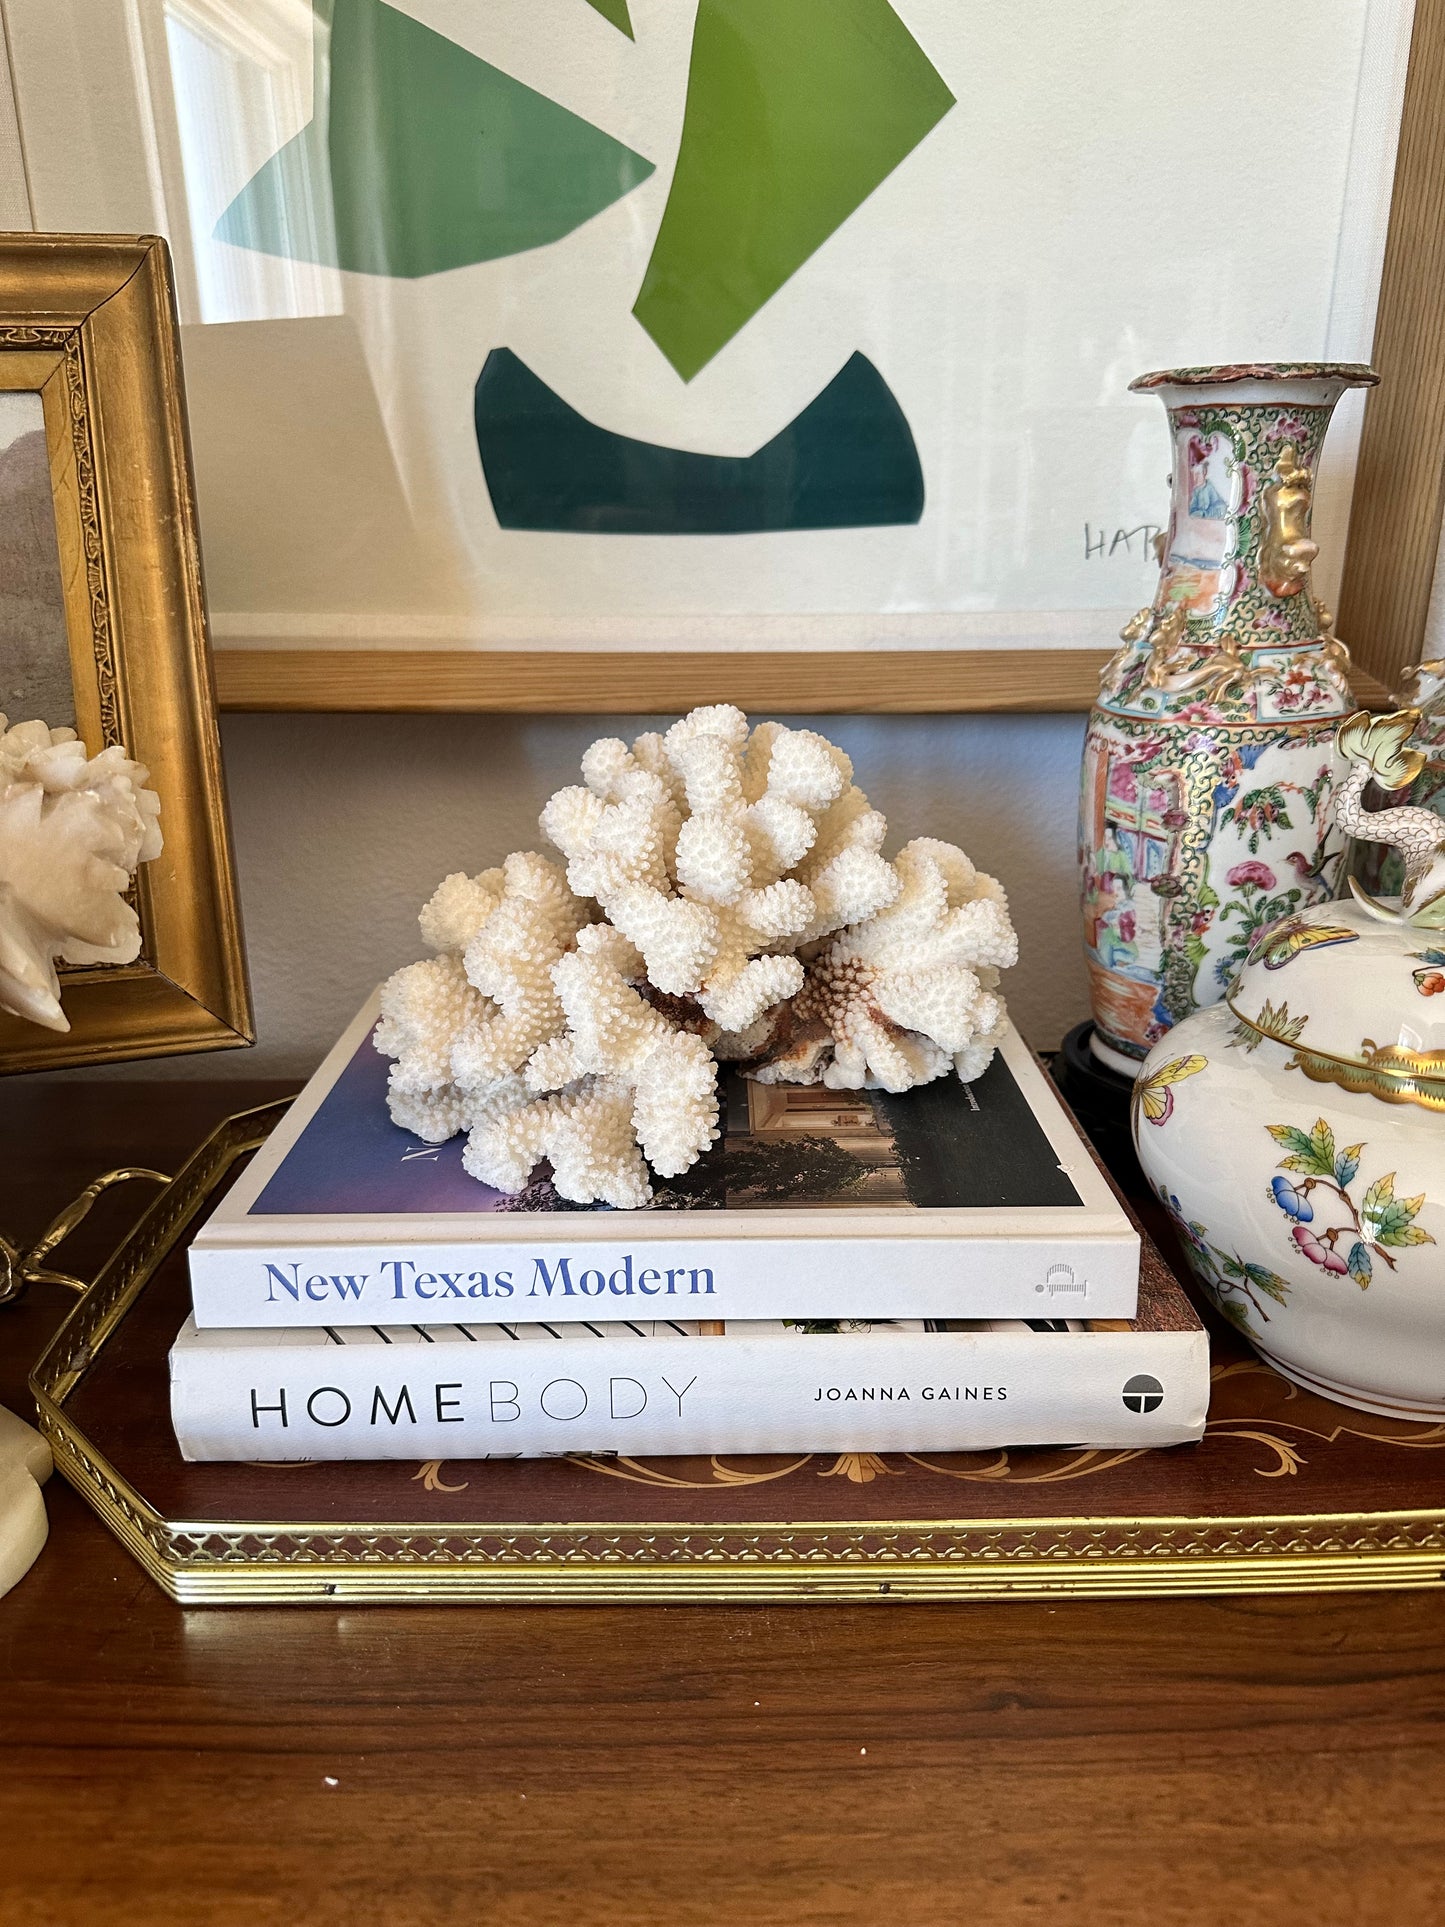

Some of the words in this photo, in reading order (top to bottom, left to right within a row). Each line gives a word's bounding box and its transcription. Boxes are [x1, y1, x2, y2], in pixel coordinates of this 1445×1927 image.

[263, 1263, 368, 1302] New
[380, 1260, 514, 1299] Texas
[526, 1255, 718, 1297] Modern
[251, 1376, 698, 1428] HOMEBODY
[814, 1387, 911, 1402] JOANNA
[921, 1386, 1008, 1401] GAINES
